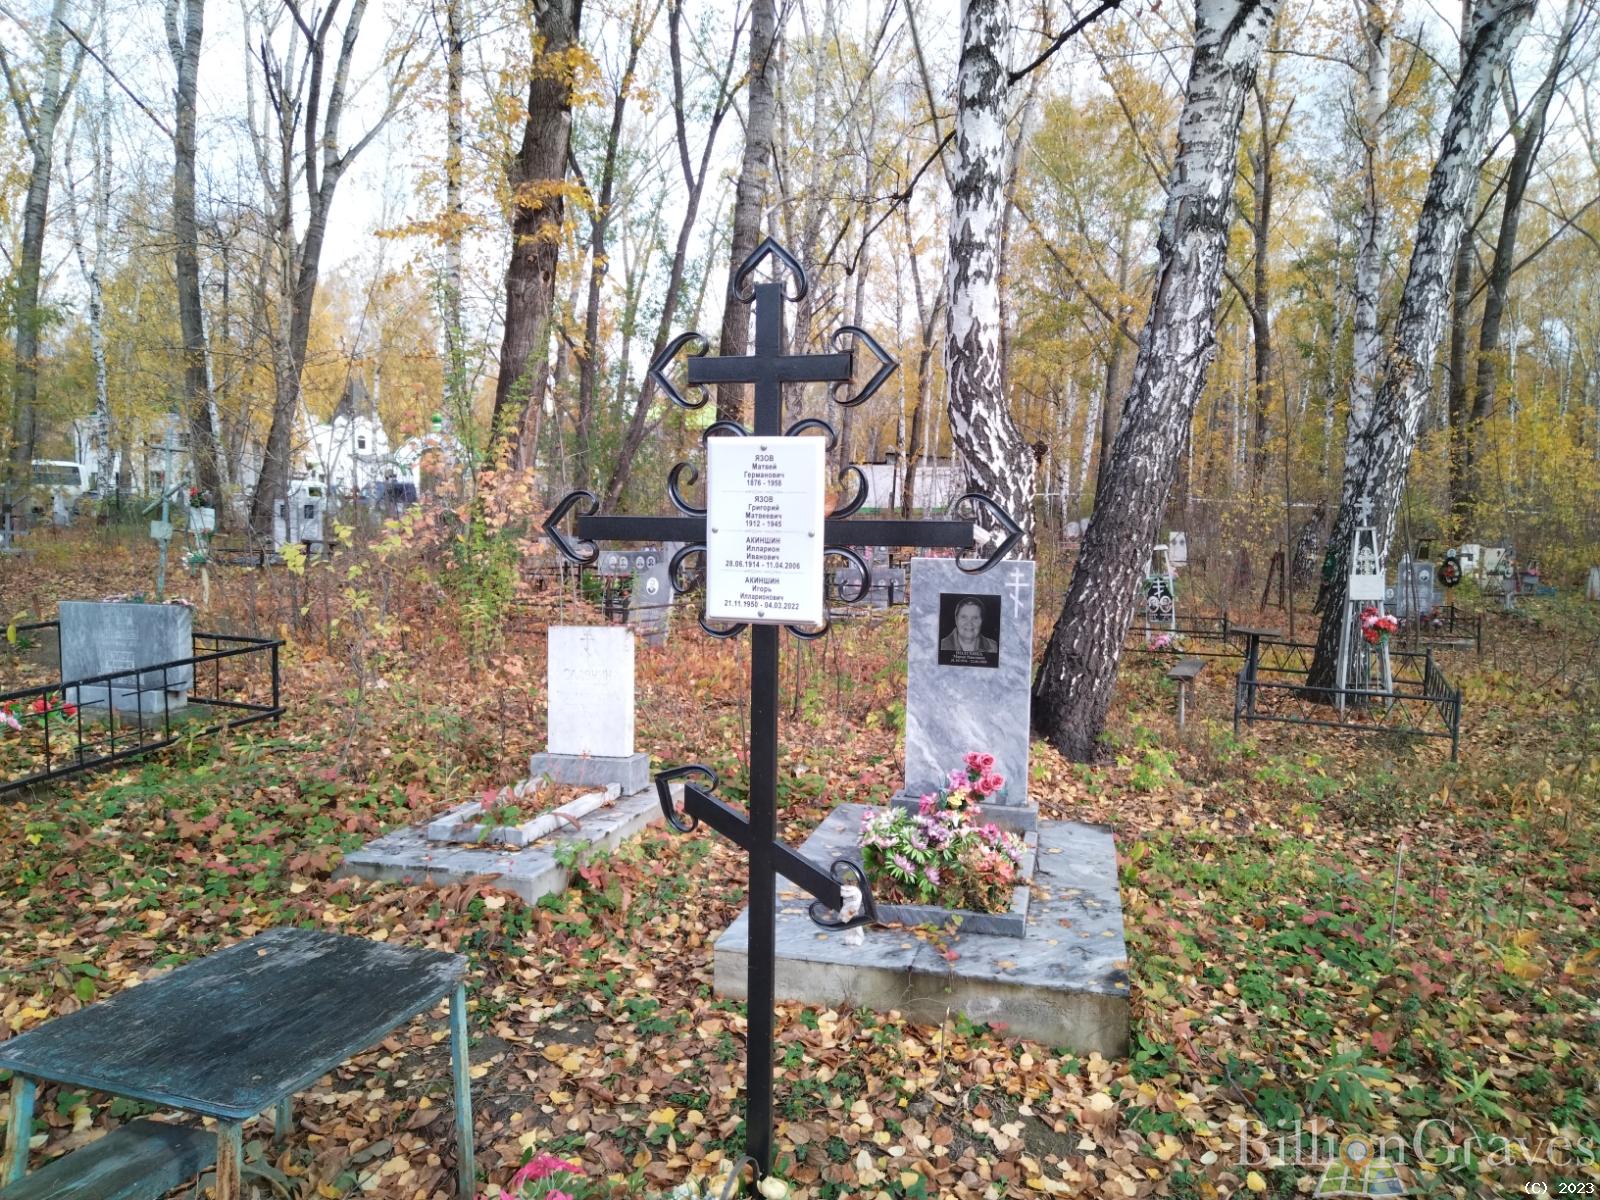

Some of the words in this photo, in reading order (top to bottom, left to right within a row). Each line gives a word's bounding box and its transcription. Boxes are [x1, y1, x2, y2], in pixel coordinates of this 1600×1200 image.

[744, 471, 785, 479] Германович
[754, 495, 774, 503] ЯЗОВ
[748, 503, 780, 512] Григорий
[745, 511, 782, 519] Матвеевич
[745, 536, 781, 544] АКИНШИН
[746, 545, 780, 553] Илларион
[752, 585, 772, 593] Игорь
[740, 592, 784, 601] Илларионович
